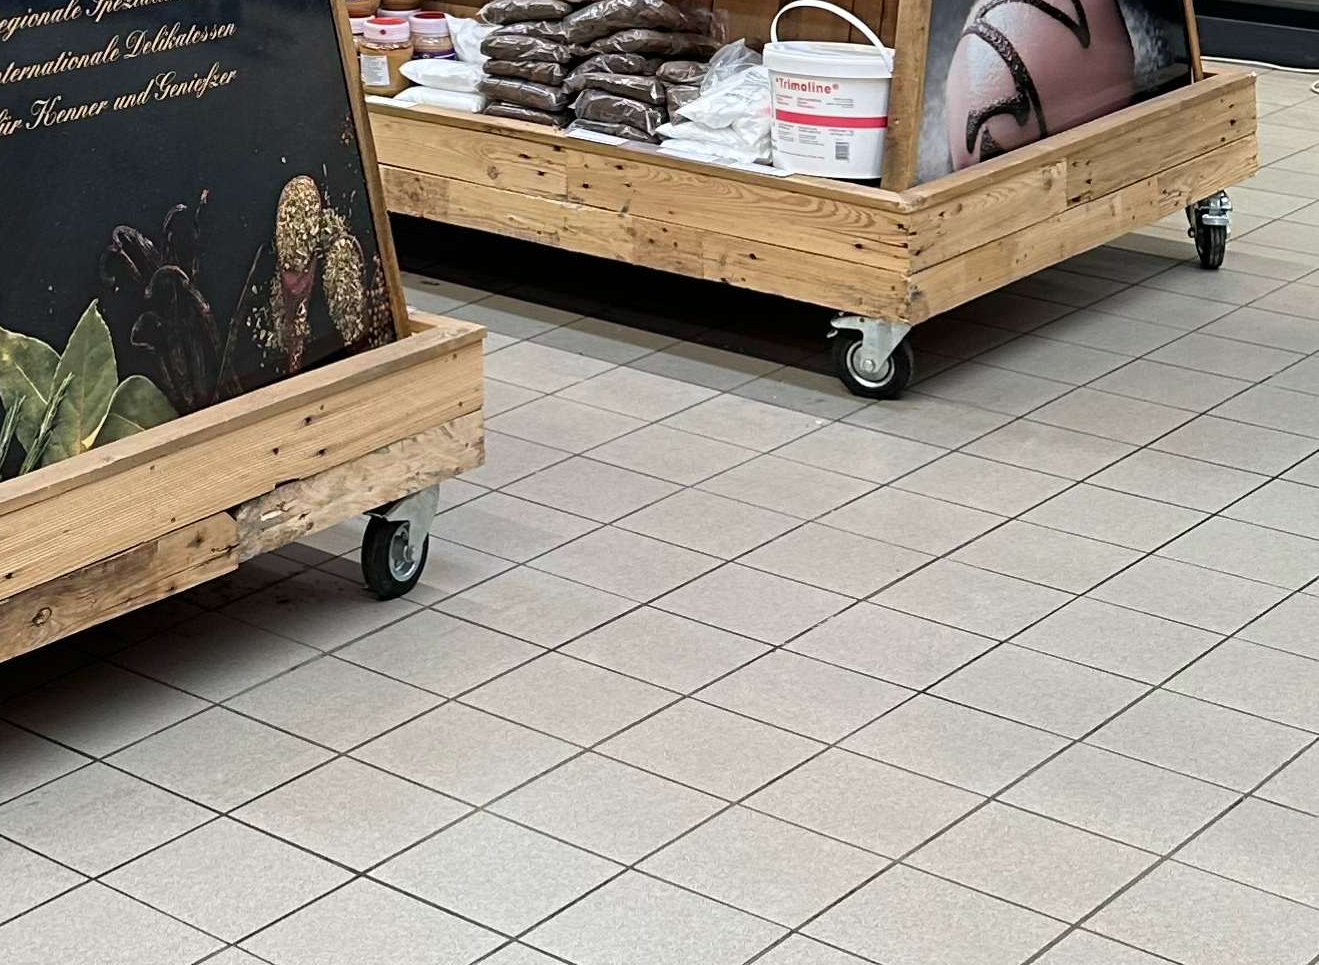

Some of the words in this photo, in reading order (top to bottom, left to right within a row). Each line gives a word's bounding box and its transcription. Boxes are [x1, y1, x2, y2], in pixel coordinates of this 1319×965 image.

[123, 20, 237, 59] Delikatessen
[25, 95, 109, 130] Kenner
[113, 79, 155, 111] und
[154, 61, 237, 101] Genießer
